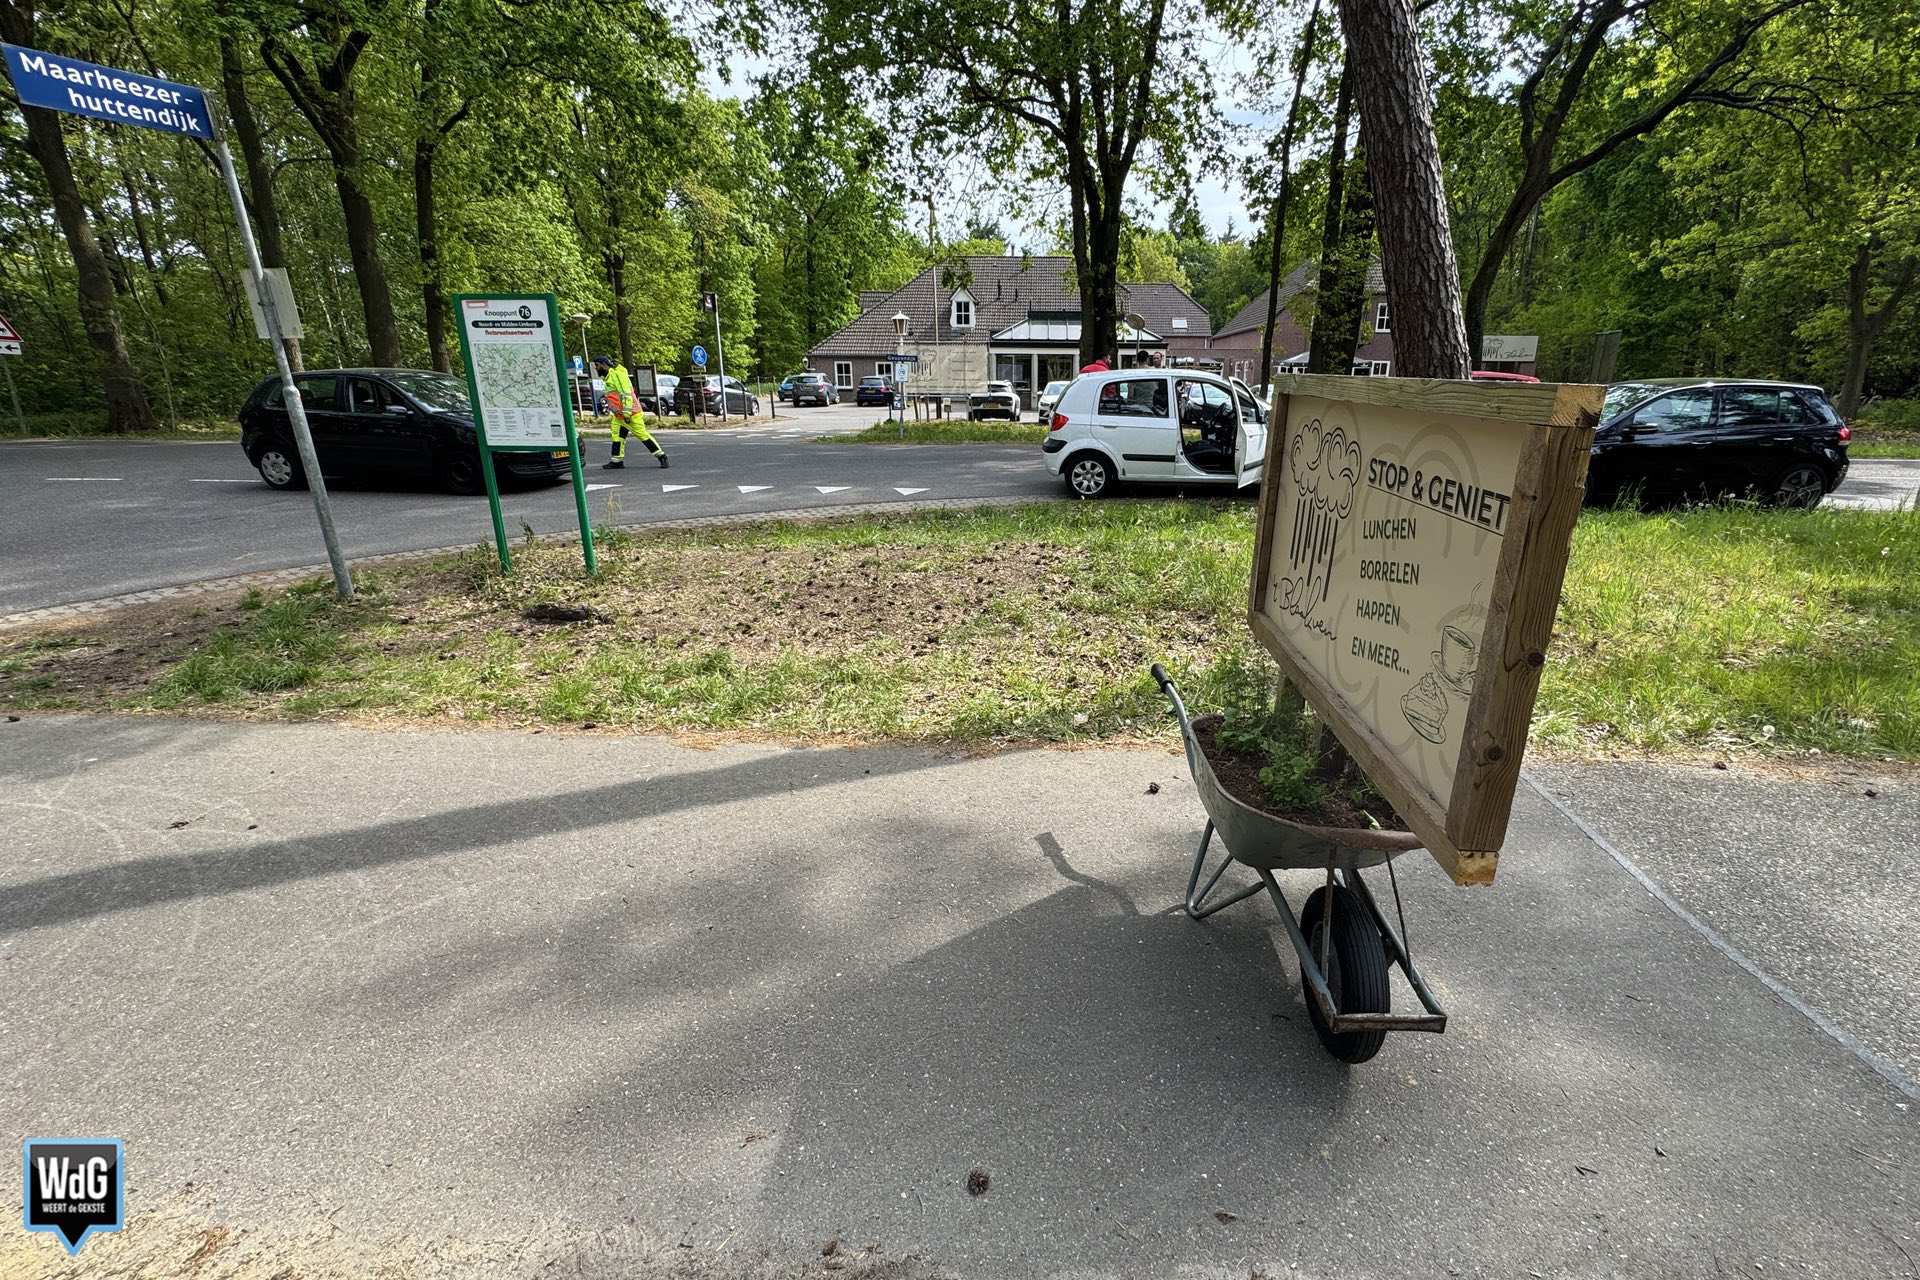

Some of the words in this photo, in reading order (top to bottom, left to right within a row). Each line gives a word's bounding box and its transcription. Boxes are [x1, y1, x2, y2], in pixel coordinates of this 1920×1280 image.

[18, 52, 193, 105] Maarheezer-
[68, 88, 200, 132] huttendijk
[484, 310, 517, 318] Knooppunt
[519, 307, 531, 317] 76
[1368, 457, 1408, 493] STOP
[1411, 473, 1425, 499] &
[1428, 475, 1511, 530] GENIET
[1362, 517, 1416, 541] LUNCHEN
[1360, 559, 1419, 586] BORRELEN
[1356, 599, 1400, 626] HAPPEN
[1351, 636, 1365, 659] EN
[1367, 641, 1410, 675] MEER...
